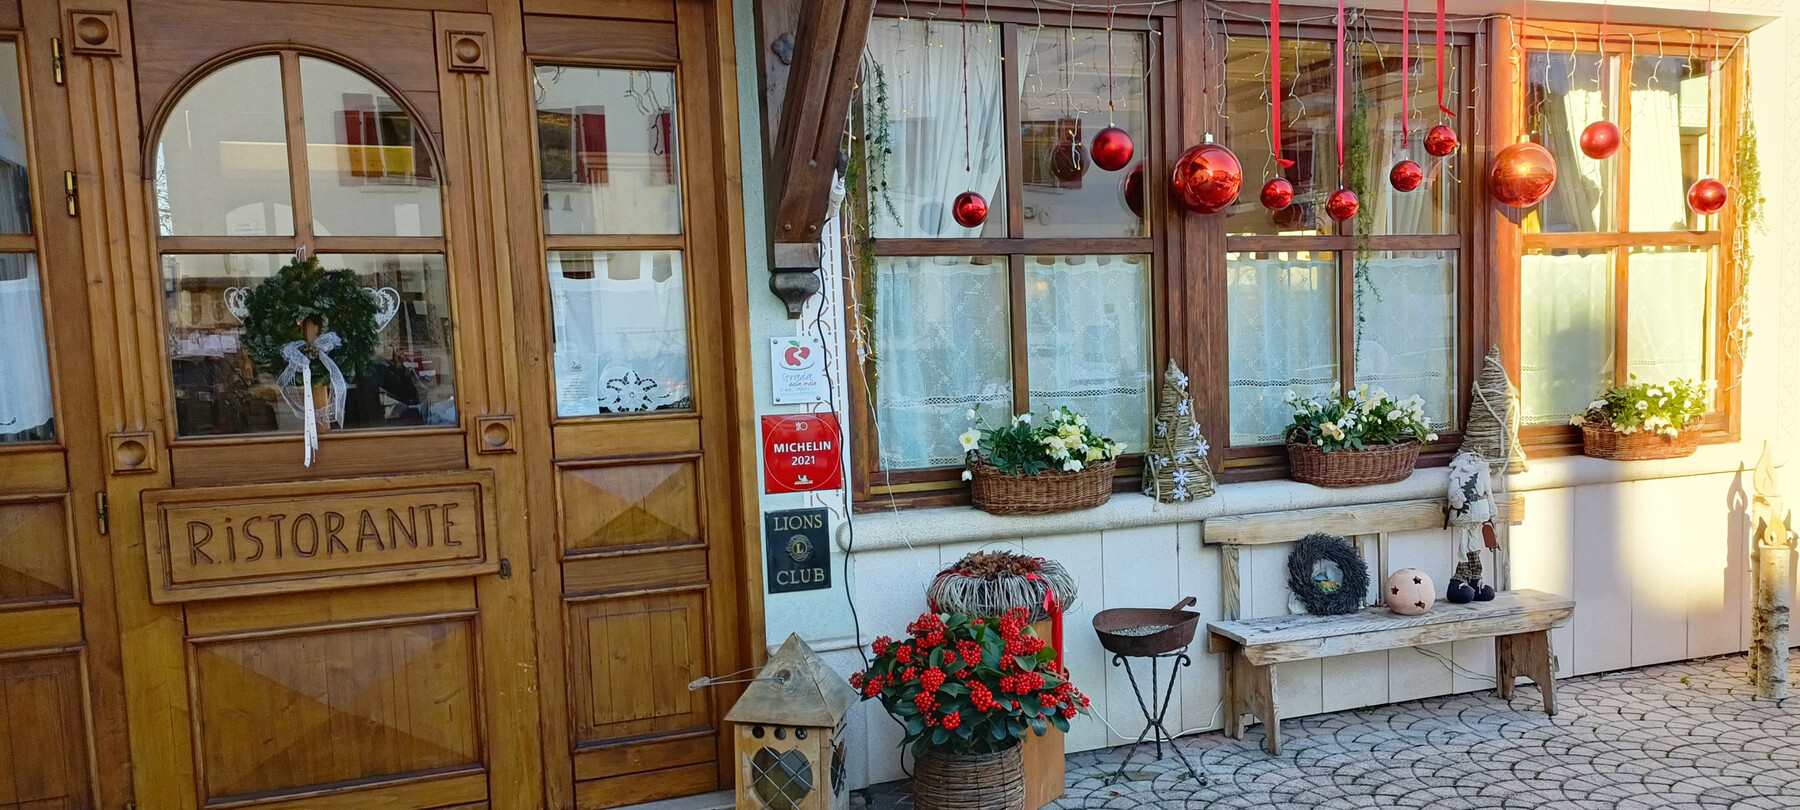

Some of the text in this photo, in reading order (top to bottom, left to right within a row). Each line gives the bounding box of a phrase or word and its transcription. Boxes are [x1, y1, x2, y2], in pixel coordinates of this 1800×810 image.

[773, 441, 832, 454] MICHELIN
[791, 455, 816, 466] 2021
[774, 513, 823, 531] LIONS
[796, 543, 804, 554] L
[776, 567, 825, 586] CLUB
